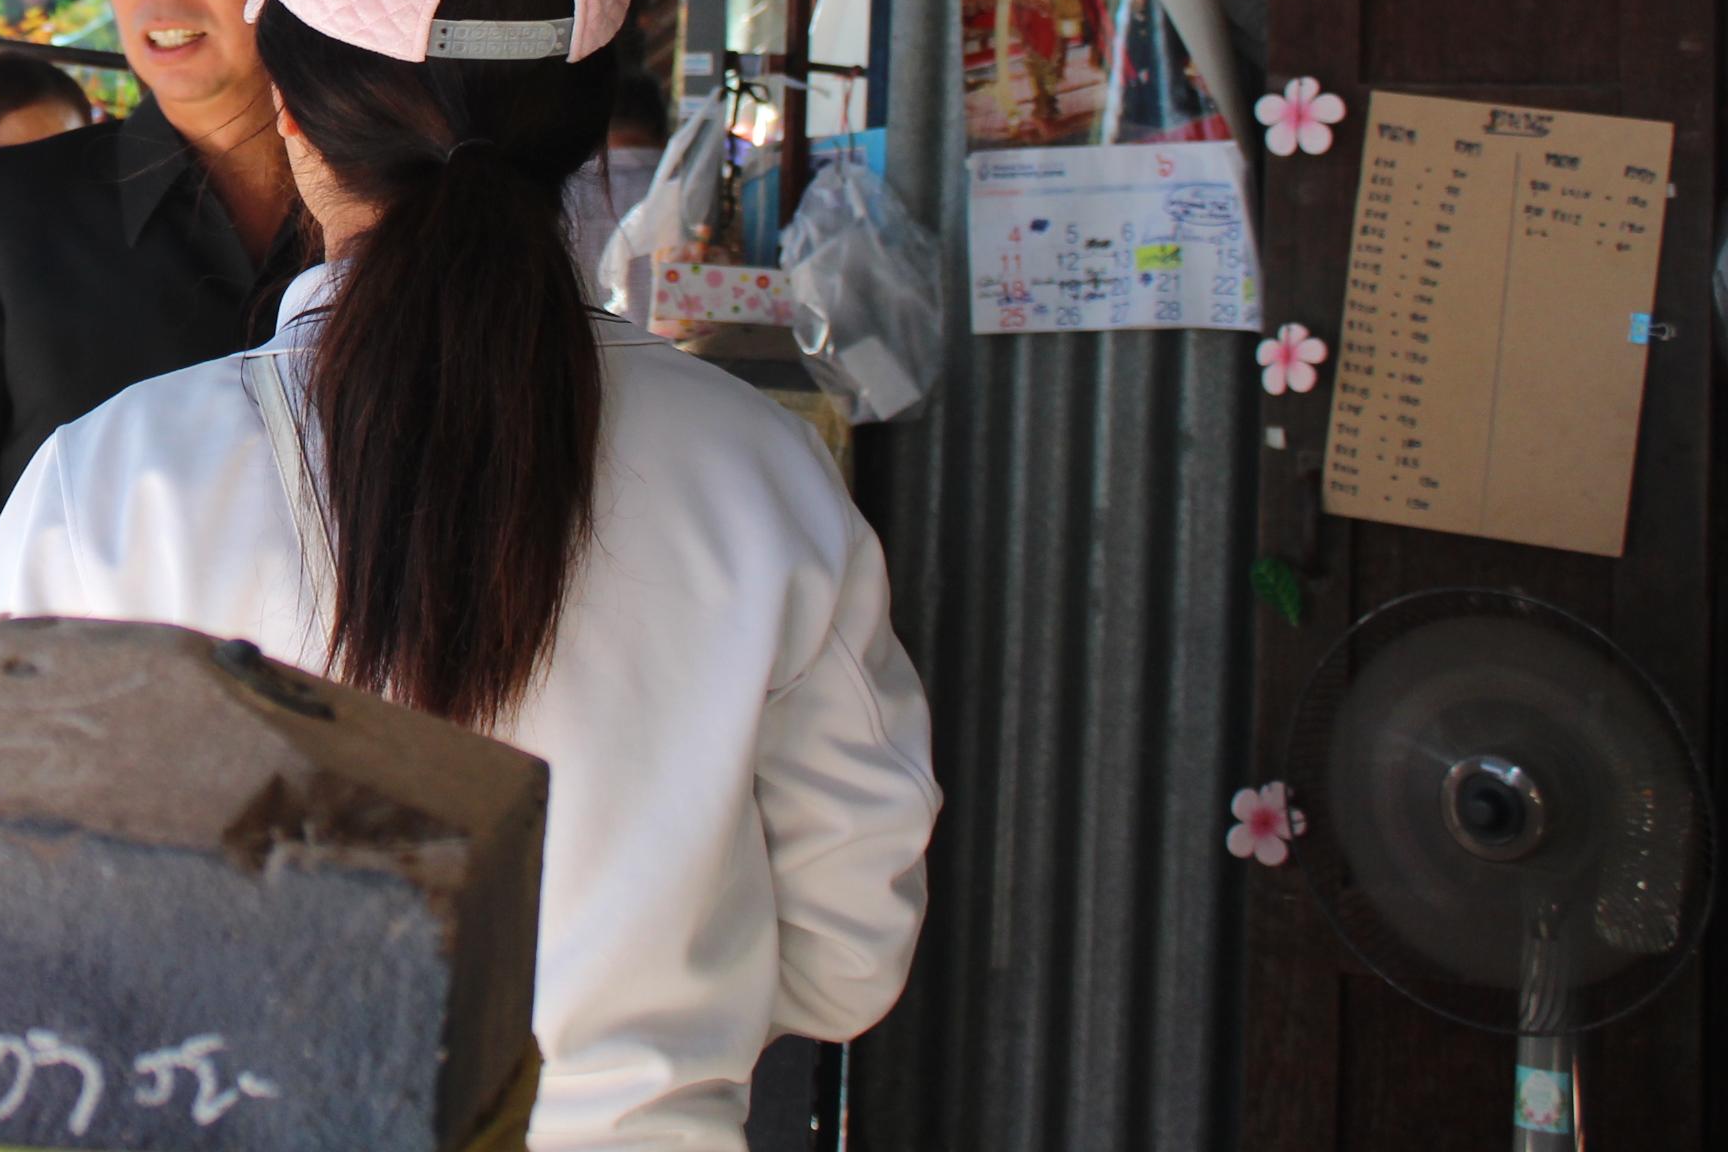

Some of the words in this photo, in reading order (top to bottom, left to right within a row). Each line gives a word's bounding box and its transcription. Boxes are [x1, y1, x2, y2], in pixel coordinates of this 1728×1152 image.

[1008, 225, 1021, 242] 4
[1065, 223, 1080, 244] 5
[1121, 222, 1134, 243] 6
[1001, 254, 1022, 272] 11
[1056, 252, 1080, 271] 12
[1216, 248, 1240, 269] 15
[1157, 274, 1180, 293] 21
[1213, 276, 1239, 296] 22
[999, 307, 1027, 328] 25
[1056, 307, 1081, 326] 26
[1156, 301, 1182, 321] 28
[1213, 303, 1238, 323] 29
